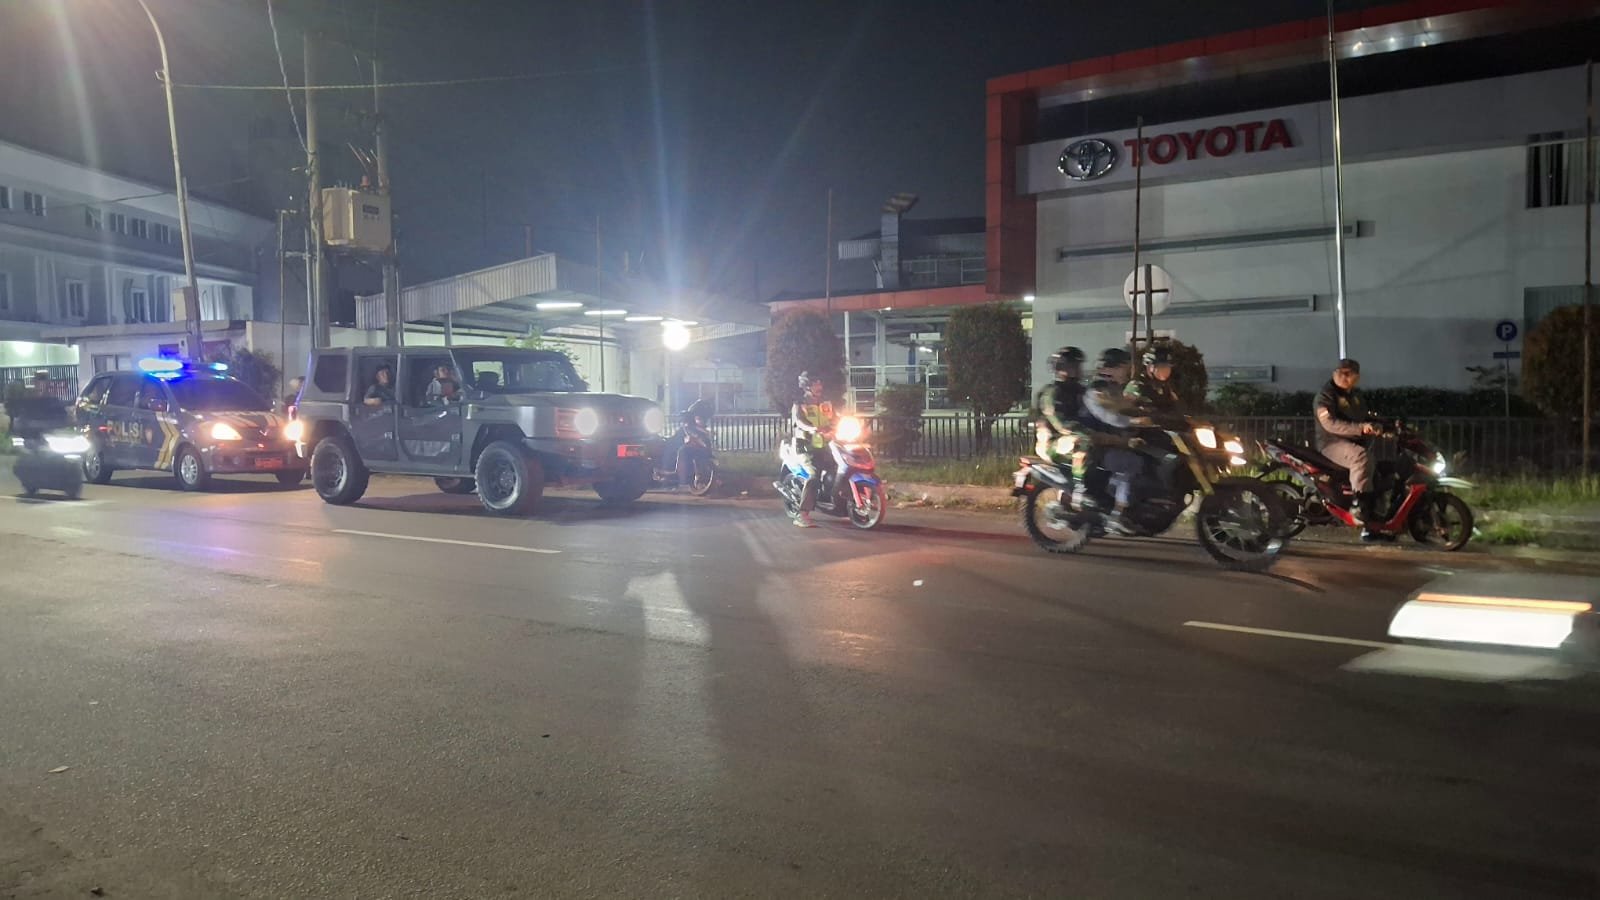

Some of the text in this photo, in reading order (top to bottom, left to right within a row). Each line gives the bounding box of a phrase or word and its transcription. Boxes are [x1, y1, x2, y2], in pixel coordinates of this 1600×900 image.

[1124, 118, 1295, 167] TOYOTA
[1502, 324, 1513, 339] P
[106, 420, 144, 439] POLISI
